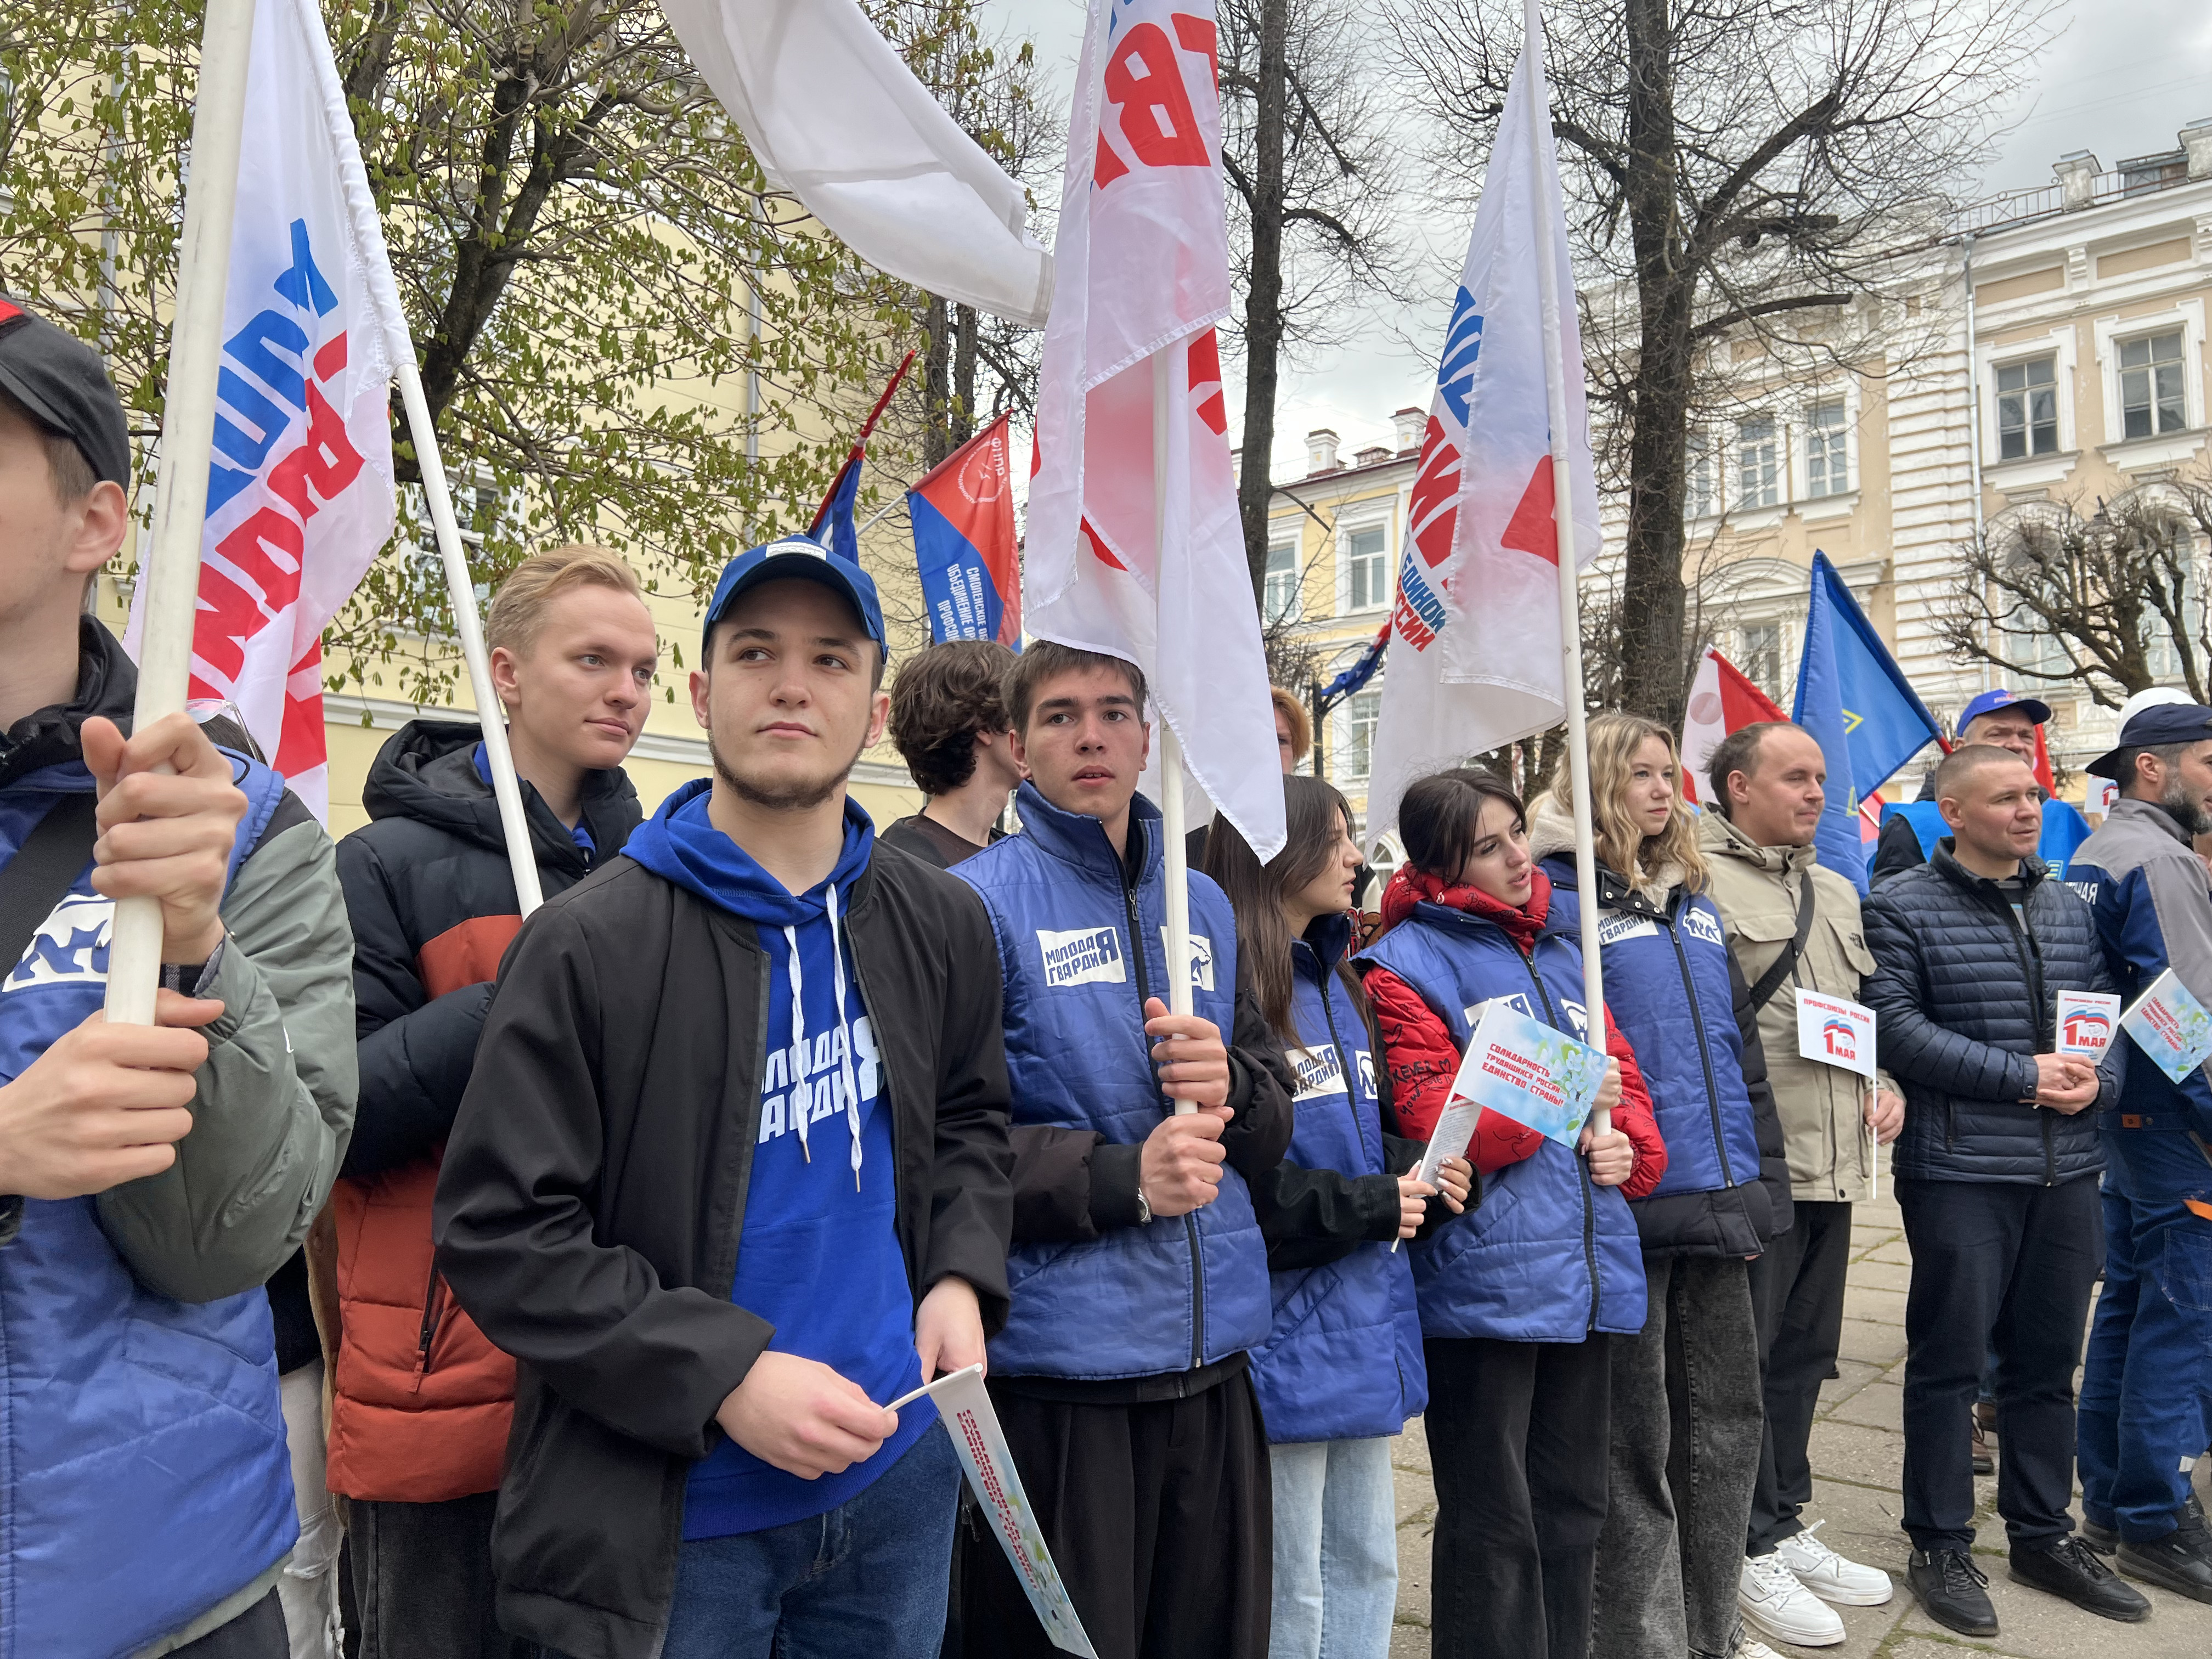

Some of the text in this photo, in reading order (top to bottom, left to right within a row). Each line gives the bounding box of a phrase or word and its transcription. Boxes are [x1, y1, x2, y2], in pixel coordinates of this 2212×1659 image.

[946, 563, 974, 626] ОБЪЕДИНЕНИЕ
[966, 567, 986, 626] СМОЛЕНСКОЕ
[1045, 928, 1119, 966] МОЛОДАЯ
[1804, 998, 1870, 1024] ПРОФСОЮЗЫ РОССИИ
[1824, 1032, 1834, 1054] 1
[1835, 1045, 1856, 1060] МАЯ
[2063, 1023, 2078, 1045] 1
[2079, 1036, 2107, 1047] МАЯ
[1486, 1053, 1534, 1080] ТРУДЯЩИХСЯ
[1489, 1043, 1551, 1077] СОЛИДАРНОСТЬ
[1481, 1062, 1564, 1107] ЕДИНСТВО СТРАНЫ!
